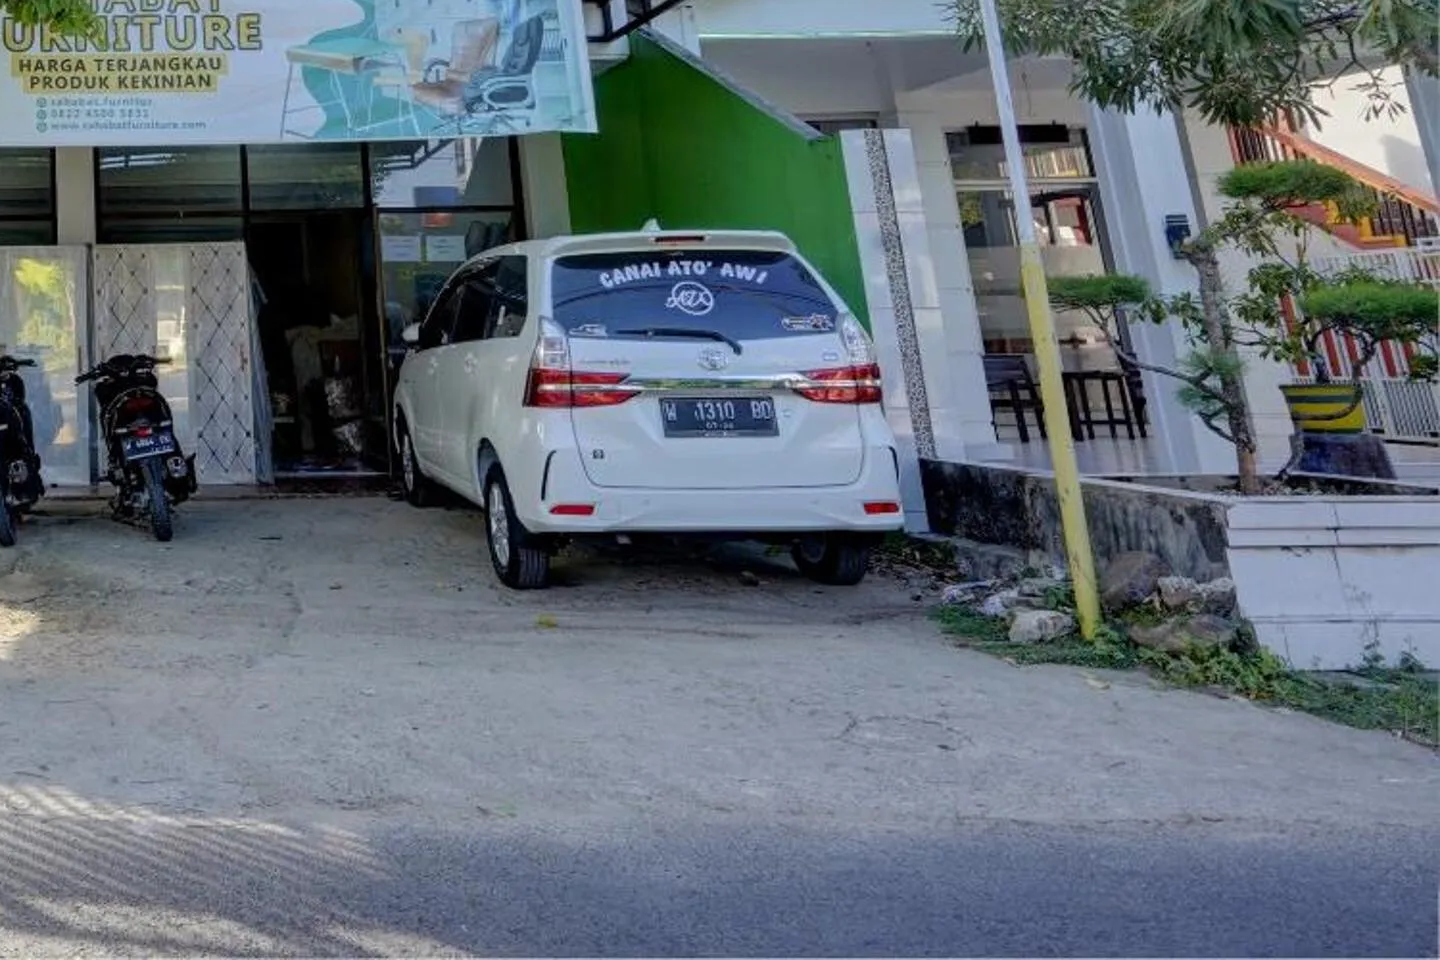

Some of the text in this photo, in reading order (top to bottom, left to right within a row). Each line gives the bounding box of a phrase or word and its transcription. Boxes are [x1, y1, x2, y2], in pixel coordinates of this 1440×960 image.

[19, 56, 222, 73] HARGA TERJANGKAU
[29, 74, 212, 90] PRODUK KEKINIAN
